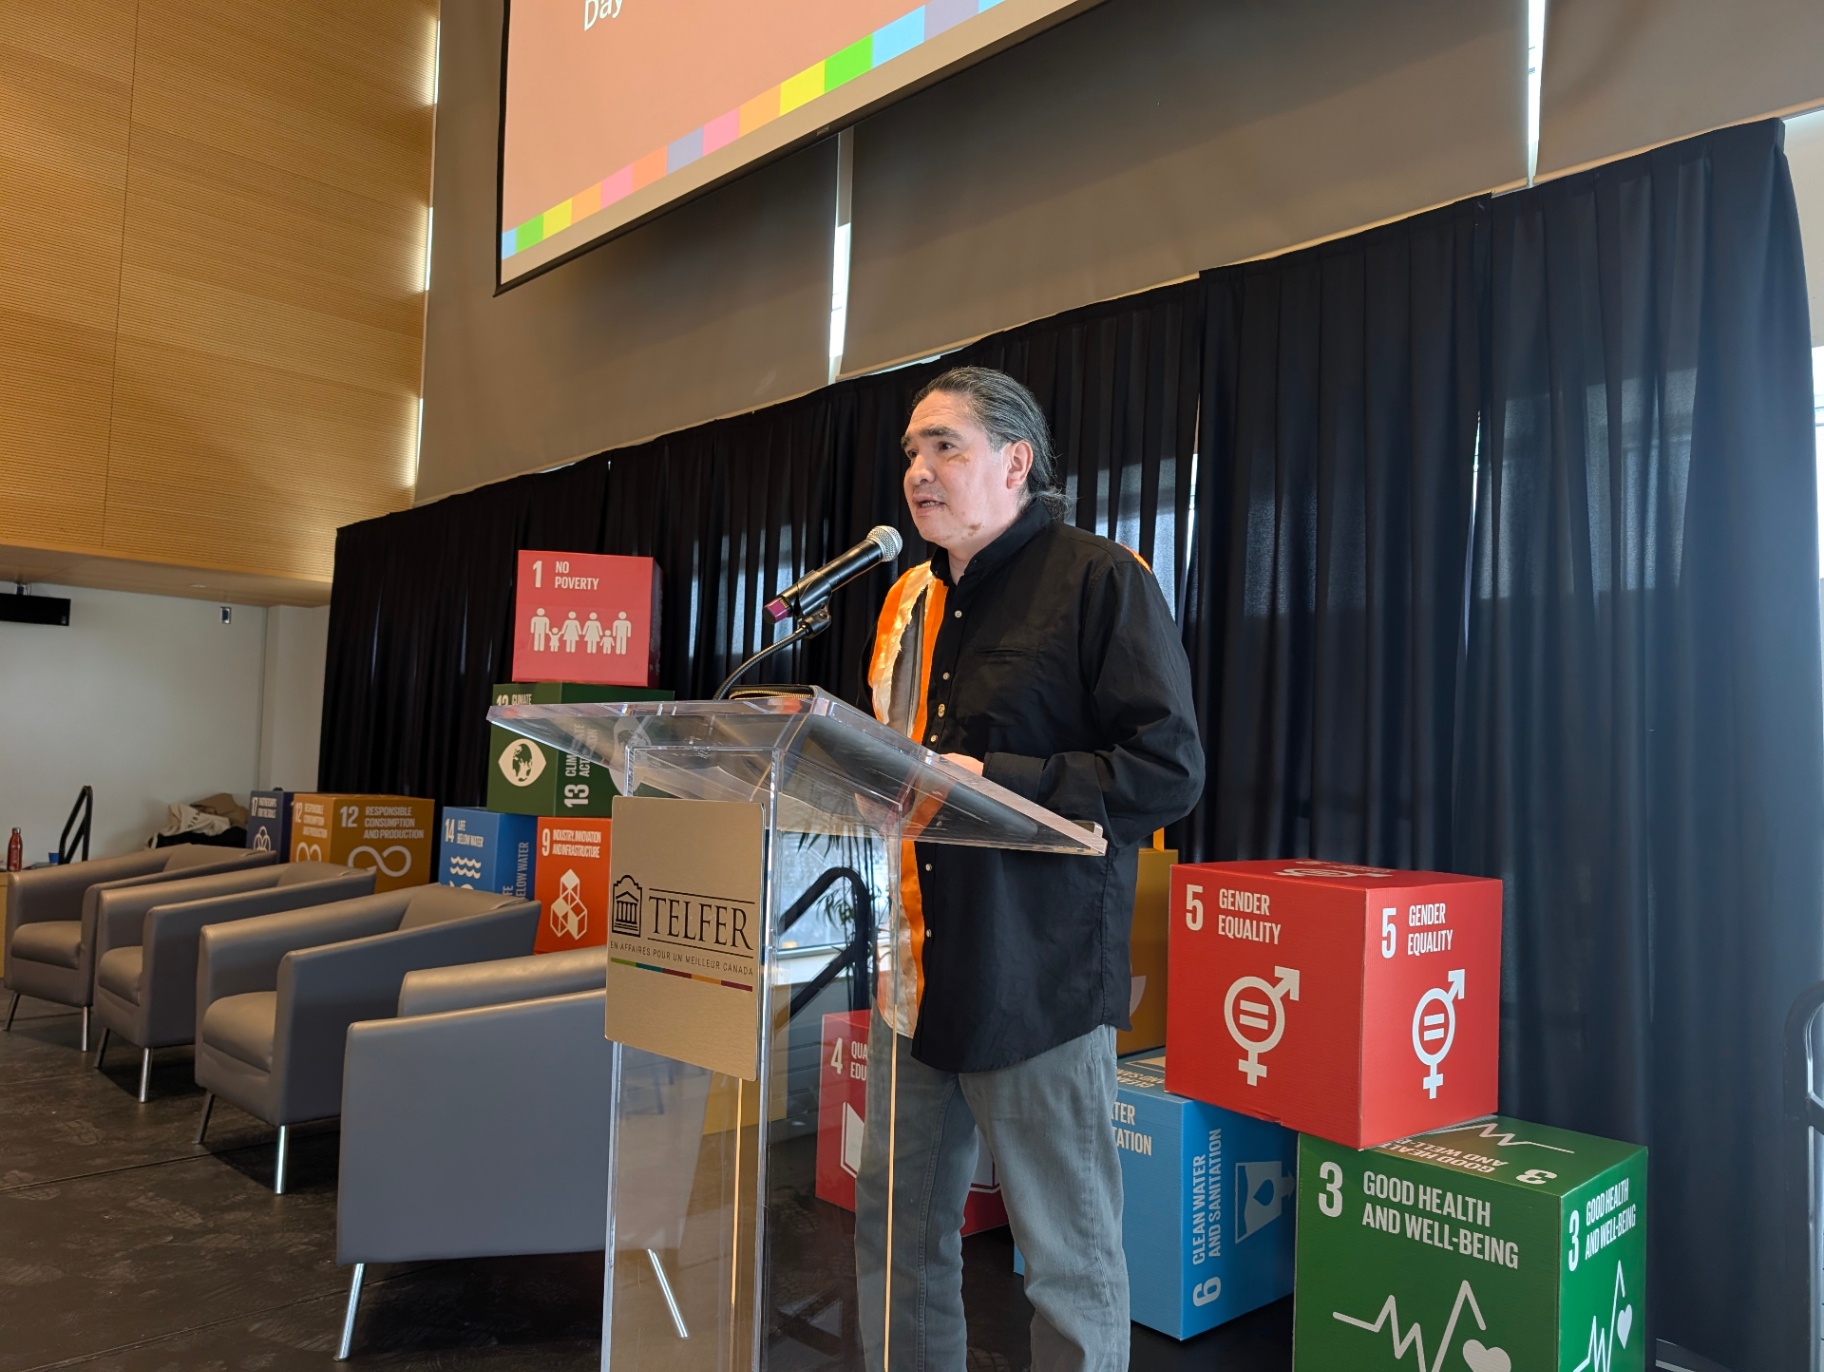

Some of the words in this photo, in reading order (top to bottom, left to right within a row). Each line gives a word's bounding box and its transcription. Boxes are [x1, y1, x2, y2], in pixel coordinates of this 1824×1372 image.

[533, 560, 542, 588] 1
[555, 561, 570, 574] NO
[554, 576, 599, 590] POVERTY
[564, 784, 589, 808] 13
[340, 806, 359, 828] 12
[364, 818, 415, 828] CONSUMPTION
[365, 806, 412, 816] RESPONSIBLE
[363, 829, 379, 839] AND
[380, 829, 424, 839] PRODUCTION
[445, 818, 455, 843] 14
[542, 828, 550, 857] 9
[517, 842, 529, 872] WATER
[1185, 884, 1204, 931] 5
[1219, 888, 1270, 916] GENDER
[1409, 903, 1446, 927] GENDER
[649, 896, 754, 950] TELFER
[1218, 914, 1281, 945] EQUALITY
[1381, 908, 1397, 959] 5
[1407, 929, 1453, 957] EQUALITY
[610, 941, 619, 949] EN
[620, 943, 650, 956] AFFAIRES
[653, 949, 671, 960] POUR
[673, 953, 683, 962] UN
[685, 955, 720, 970] MEILLEUR
[723, 962, 753, 976] CANADA
[831, 1037, 843, 1075] 4
[851, 1040, 868, 1060] QUA
[850, 1061, 867, 1081] EDU
[1111, 1101, 1135, 1125] TER
[1208, 1128, 1222, 1221] SANITATION
[1437, 1156, 1496, 1173] GOOD
[1465, 1153, 1510, 1167] AND
[1193, 1154, 1206, 1211] WATER
[1318, 1161, 1343, 1218] 3
[1516, 1169, 1558, 1185] 3
[1363, 1171, 1415, 1206] GOOD
[1418, 1184, 1491, 1227] HEALTH
[1586, 1192, 1605, 1227] GOOD
[1605, 1177, 1629, 1214] HEALTH
[1193, 1215, 1206, 1265] CLEAN
[1208, 1224, 1221, 1257] AND
[1362, 1202, 1400, 1235] AND
[1404, 1212, 1519, 1270] WELL-BEING
[1568, 1209, 1579, 1272] 3
[1584, 1228, 1600, 1260] AND
[1600, 1203, 1636, 1249] WELL-BEING
[1192, 1276, 1222, 1308] 6
